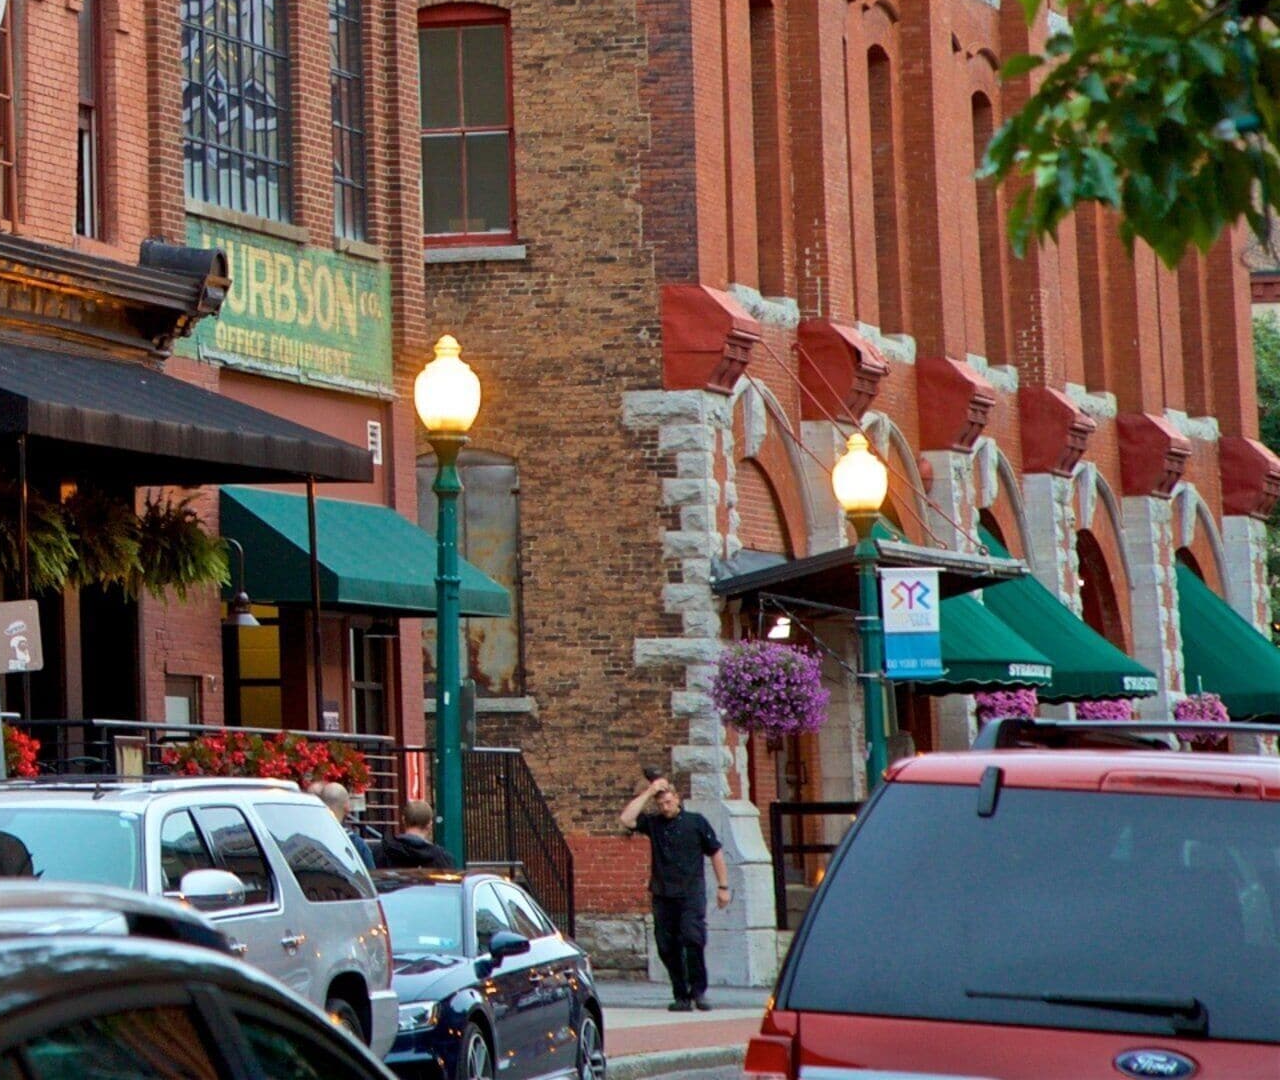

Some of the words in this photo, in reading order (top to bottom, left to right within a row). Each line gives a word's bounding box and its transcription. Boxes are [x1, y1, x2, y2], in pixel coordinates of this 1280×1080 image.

[215, 320, 266, 359] OFFICE
[270, 335, 353, 375] EQUIPMENT
[890, 580, 931, 610] SYR
